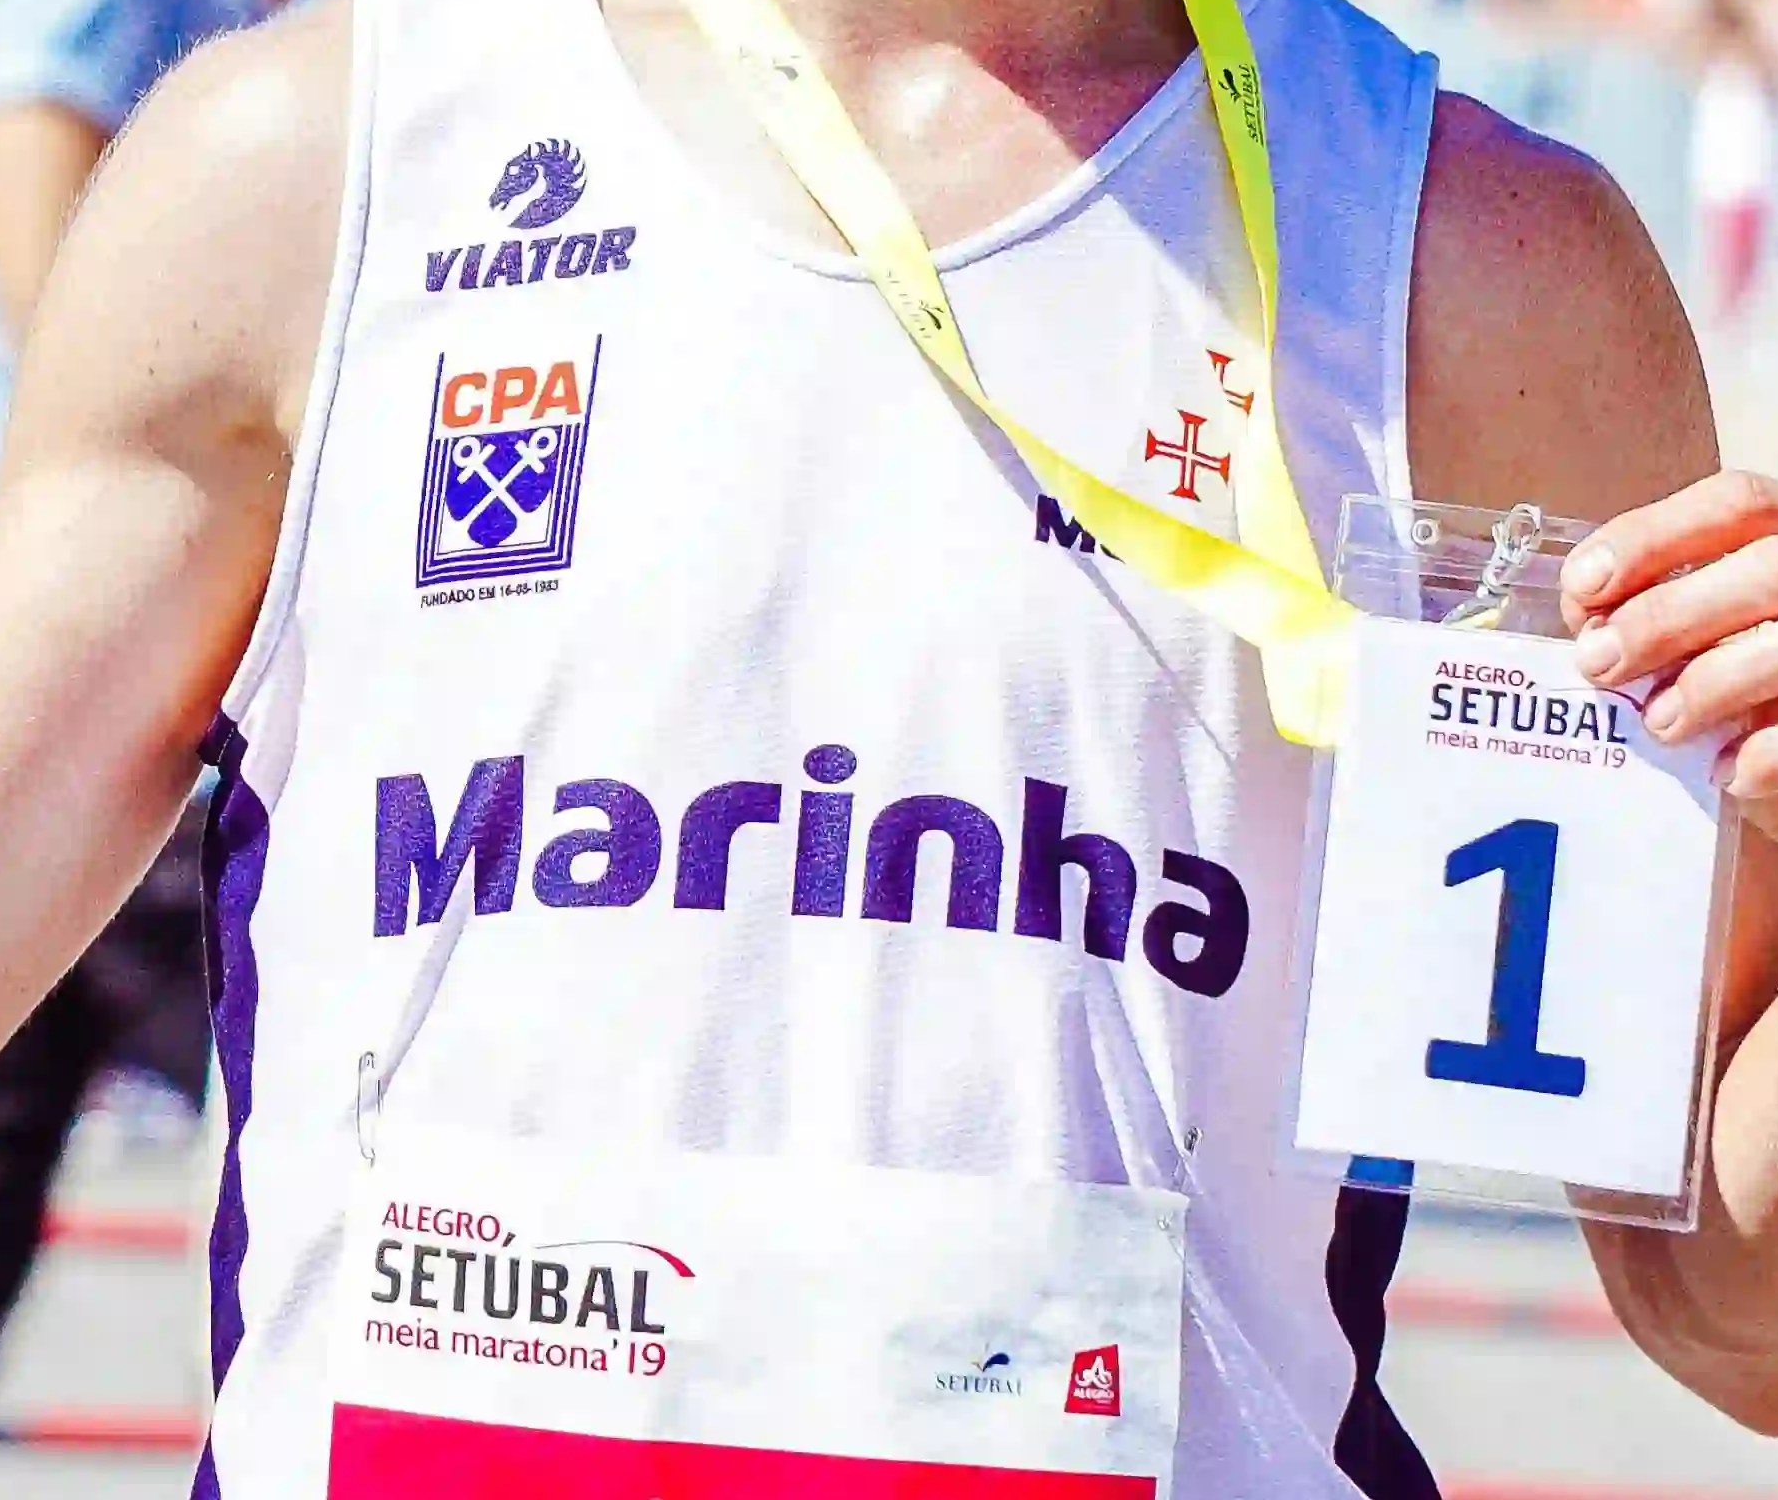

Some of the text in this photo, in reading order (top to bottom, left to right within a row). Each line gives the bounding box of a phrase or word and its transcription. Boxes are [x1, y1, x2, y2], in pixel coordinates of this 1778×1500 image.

[425, 226, 637, 292] VIATOR
[441, 361, 583, 429] CPA
[420, 588, 475, 609] FUNDADO
[478, 585, 496, 600] EM
[1435, 661, 1524, 687] ALEGRO
[1426, 729, 1479, 749] meia
[1430, 681, 1627, 744] SETÚBAL
[373, 744, 1249, 998] Marinha
[1425, 817, 1587, 1098] 1
[381, 1201, 500, 1242] ALEGRO
[371, 1231, 665, 1334] SETÚBAL
[365, 1318, 440, 1351] meia
